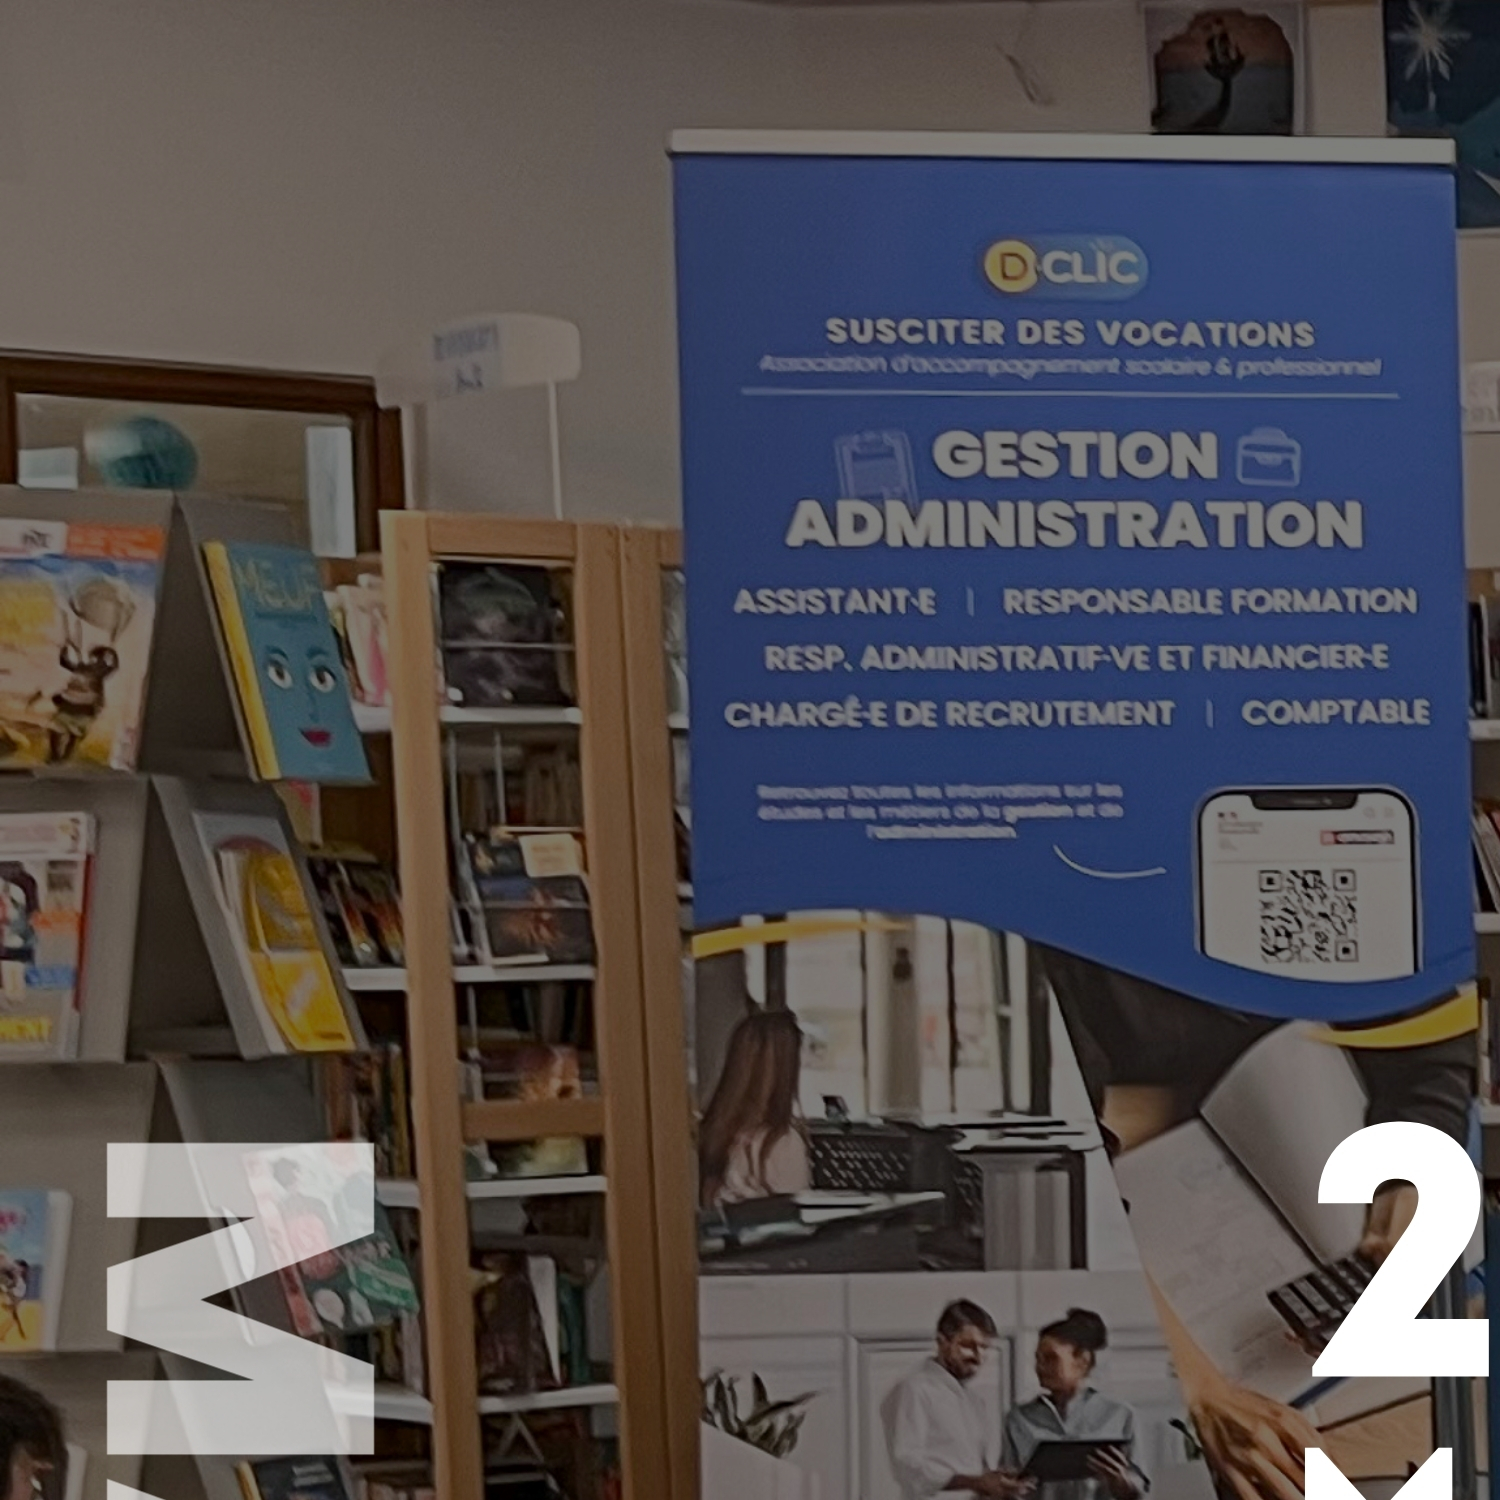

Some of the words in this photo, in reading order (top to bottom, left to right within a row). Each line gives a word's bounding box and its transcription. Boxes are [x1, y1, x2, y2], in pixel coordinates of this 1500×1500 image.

[825, 317, 1006, 346] SUSCITER
[1016, 318, 1085, 347] DES
[1096, 319, 1316, 348] VOCATIONS
[932, 430, 1219, 480] GESTION
[785, 499, 1364, 550] ADMINISTRATION
[1002, 587, 1223, 617] RESPONSABLE
[1230, 586, 1419, 615] FORMATION
[764, 644, 853, 675] RESP.
[1158, 644, 1195, 671] ET
[896, 701, 938, 728] DE
[946, 700, 1177, 728] RECRUTEMENT
[1241, 699, 1431, 727] COMPTABLE
